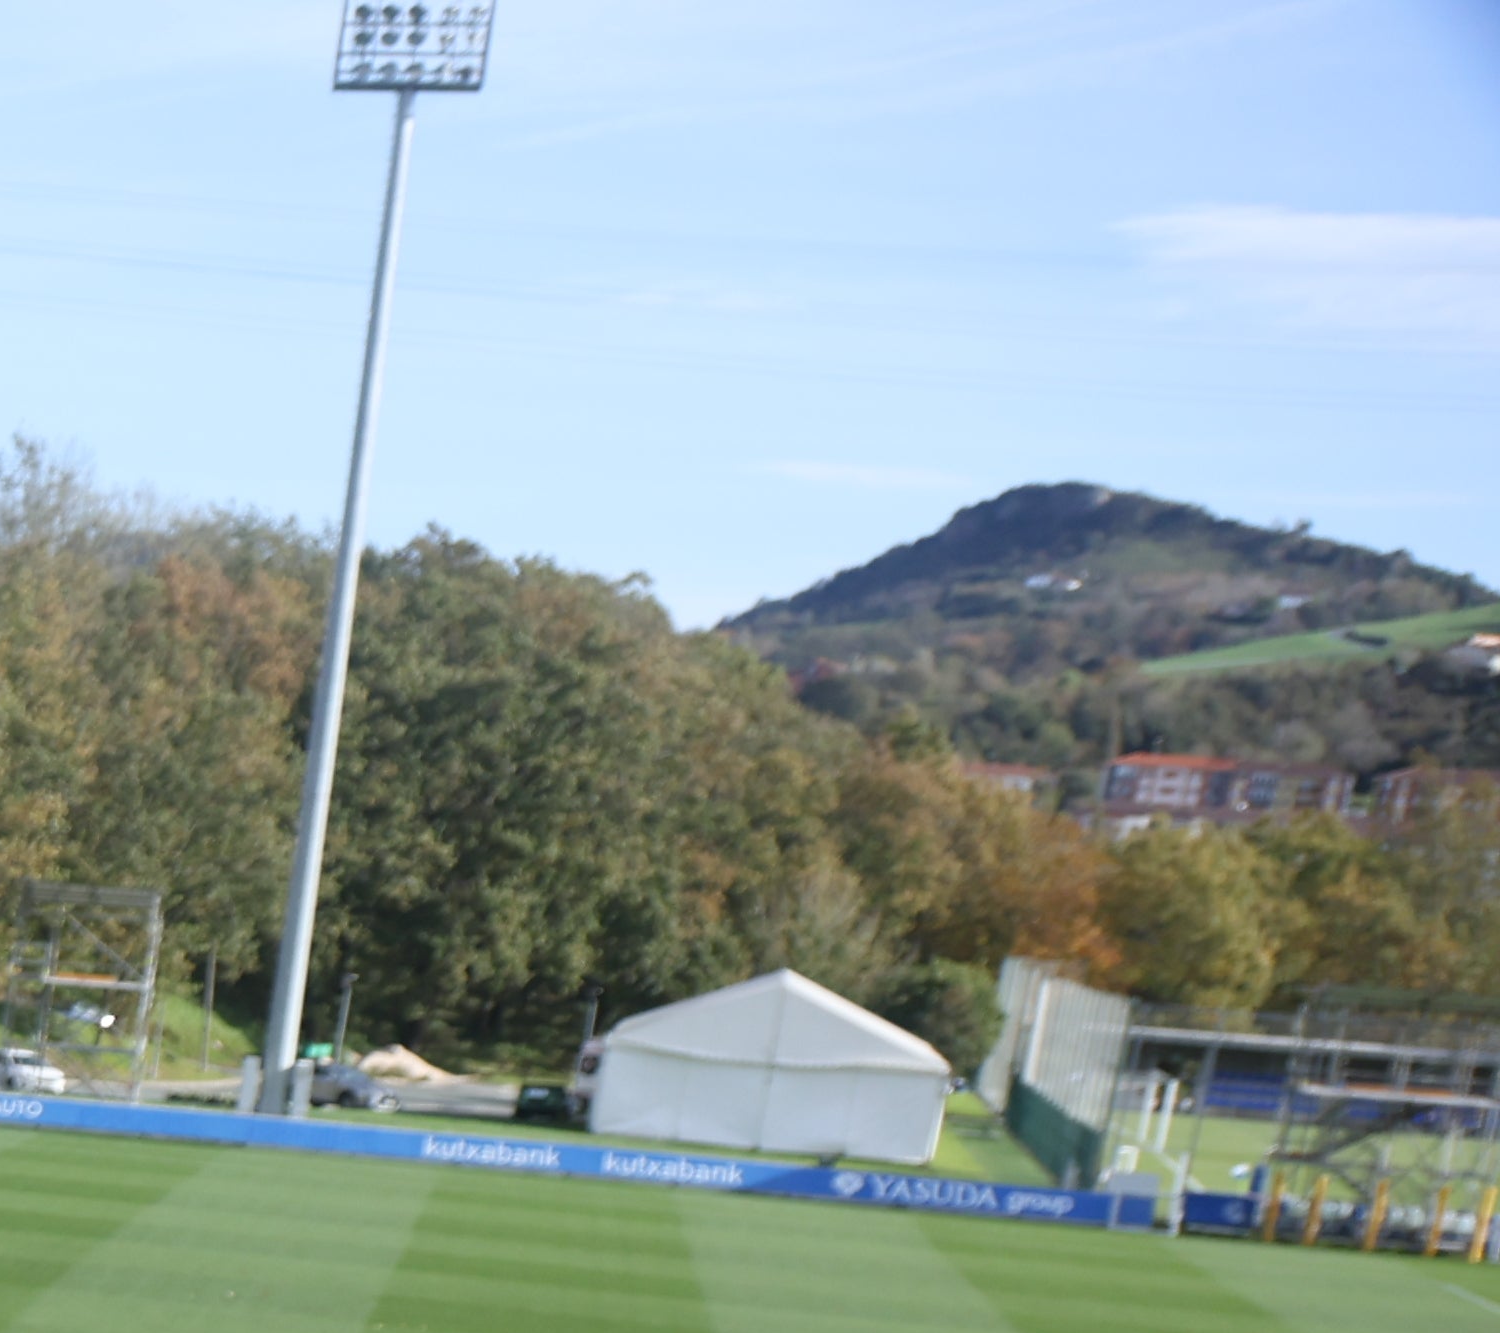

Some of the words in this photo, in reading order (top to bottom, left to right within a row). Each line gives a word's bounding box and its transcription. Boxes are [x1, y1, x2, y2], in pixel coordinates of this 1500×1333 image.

[421, 1134, 561, 1168] kutxabank
[602, 1150, 745, 1185] kutxabank
[871, 1174, 998, 1210] YASUDA
